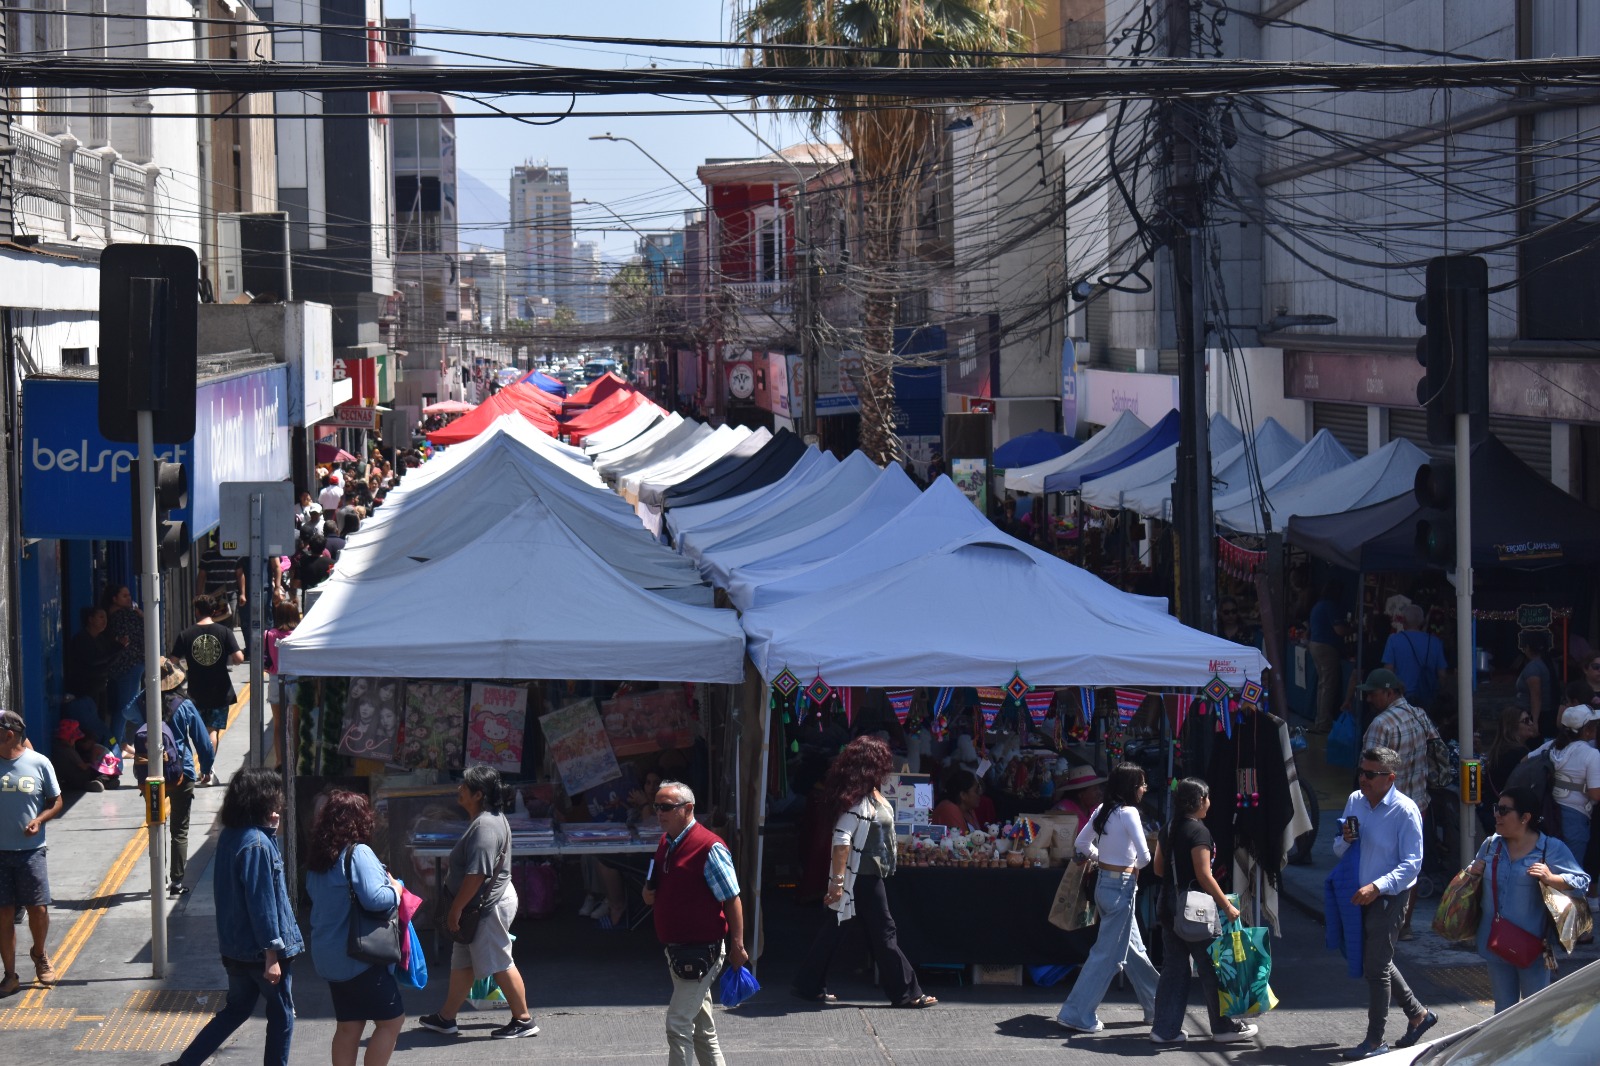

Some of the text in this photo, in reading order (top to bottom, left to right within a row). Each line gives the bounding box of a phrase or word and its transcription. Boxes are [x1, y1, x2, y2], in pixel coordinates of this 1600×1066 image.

[1111, 389, 1139, 416] Salcobrand
[340, 409, 373, 421] CECINAS
[1209, 659, 1231, 671] Master
